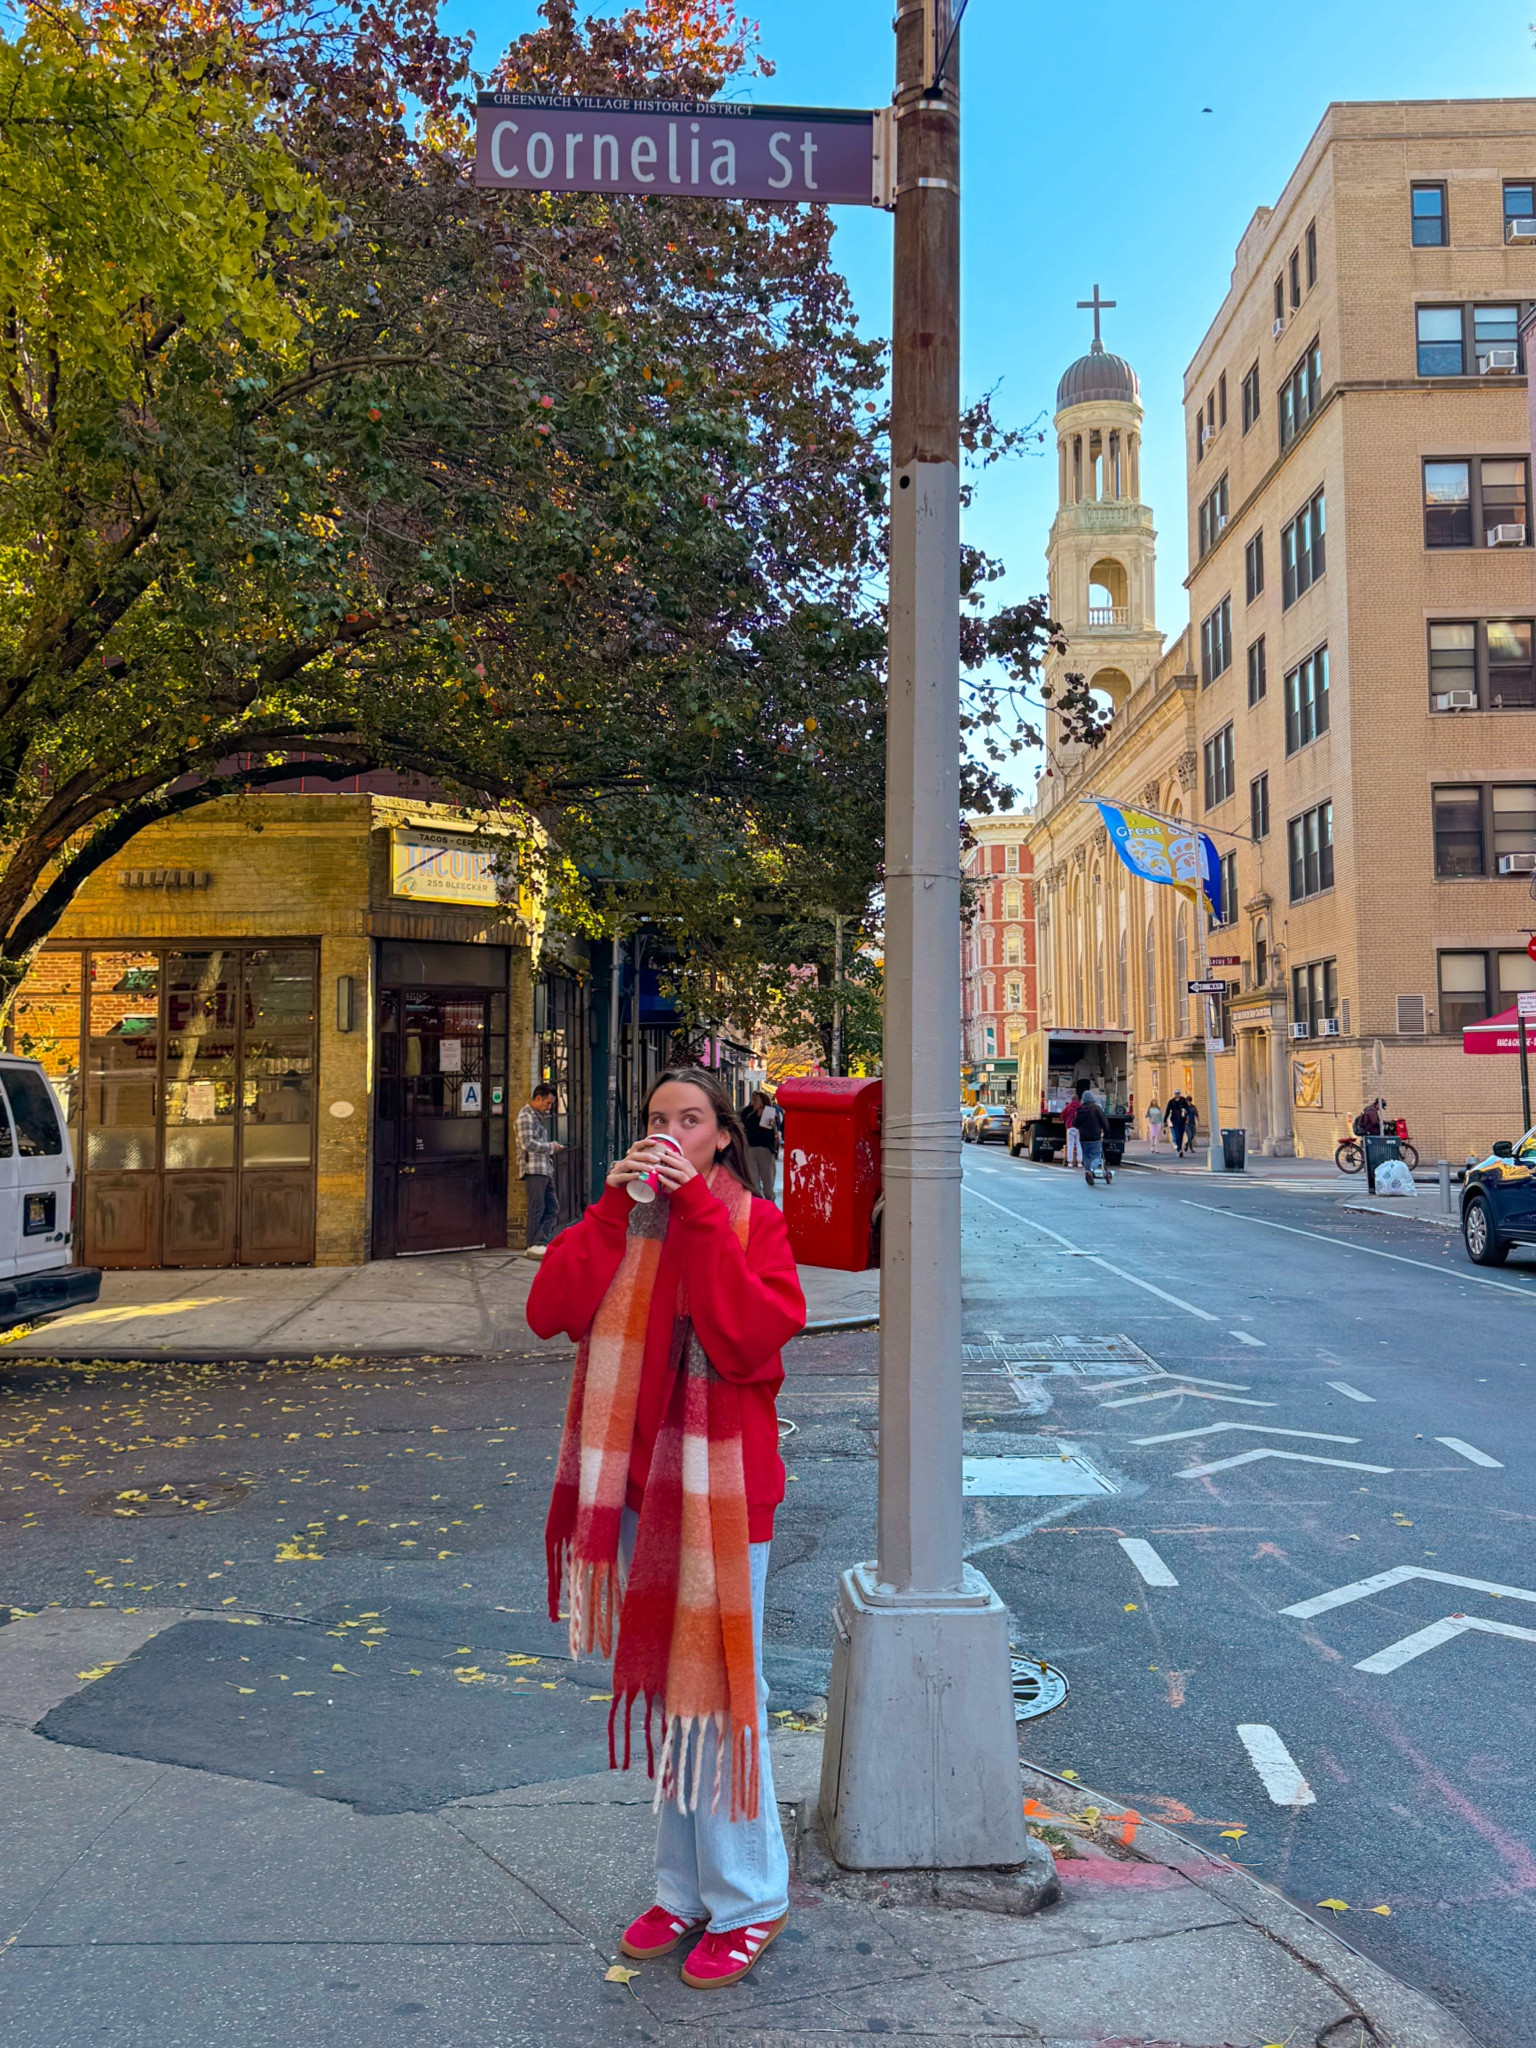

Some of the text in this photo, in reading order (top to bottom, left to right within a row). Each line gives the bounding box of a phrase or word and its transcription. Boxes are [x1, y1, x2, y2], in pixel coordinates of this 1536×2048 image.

[493, 93, 754, 116] GREENWICH VILLAGE HISTORIC DISTRICT
[490, 120, 819, 190] Cornelia St
[1115, 825, 1163, 838] Great
[419, 833, 448, 844] TACOS
[427, 879, 489, 892] 255 BLEECKER
[1209, 957, 1233, 966] Leroy St
[465, 1086, 478, 1103] A
